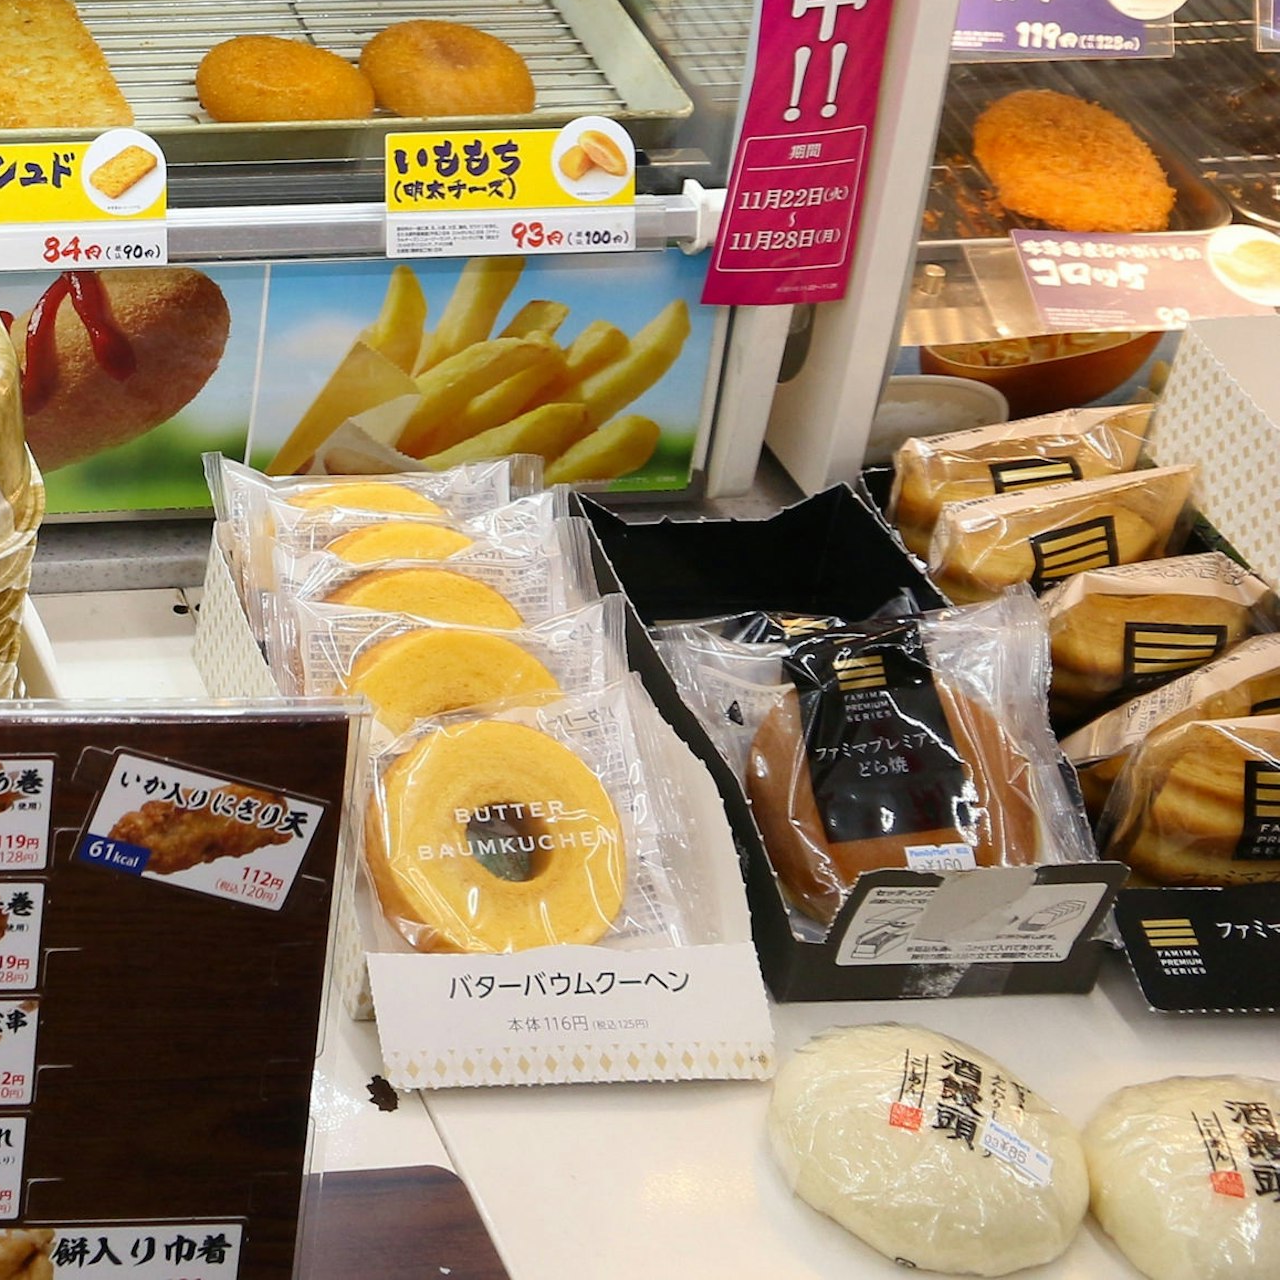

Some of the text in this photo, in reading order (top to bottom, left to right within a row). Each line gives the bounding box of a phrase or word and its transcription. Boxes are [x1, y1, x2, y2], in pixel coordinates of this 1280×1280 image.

[394, 139, 521, 177] いももち
[790, 143, 822, 160] 期間
[394, 177, 517, 202] (明太チーズ)
[511, 222, 563, 248] 93円
[42, 236, 102, 263] 84円
[858, 756, 910, 777] どら焼
[120, 768, 310, 840] いか入りにぎり天
[453, 800, 566, 824] BUTTER
[418, 828, 619, 861] BAUMKUCHEN
[449, 970, 690, 1000] バターバウムクーヘン
[932, 1050, 984, 1151] 酒饅頭
[52, 1233, 234, 1267] 餅入り巾着
